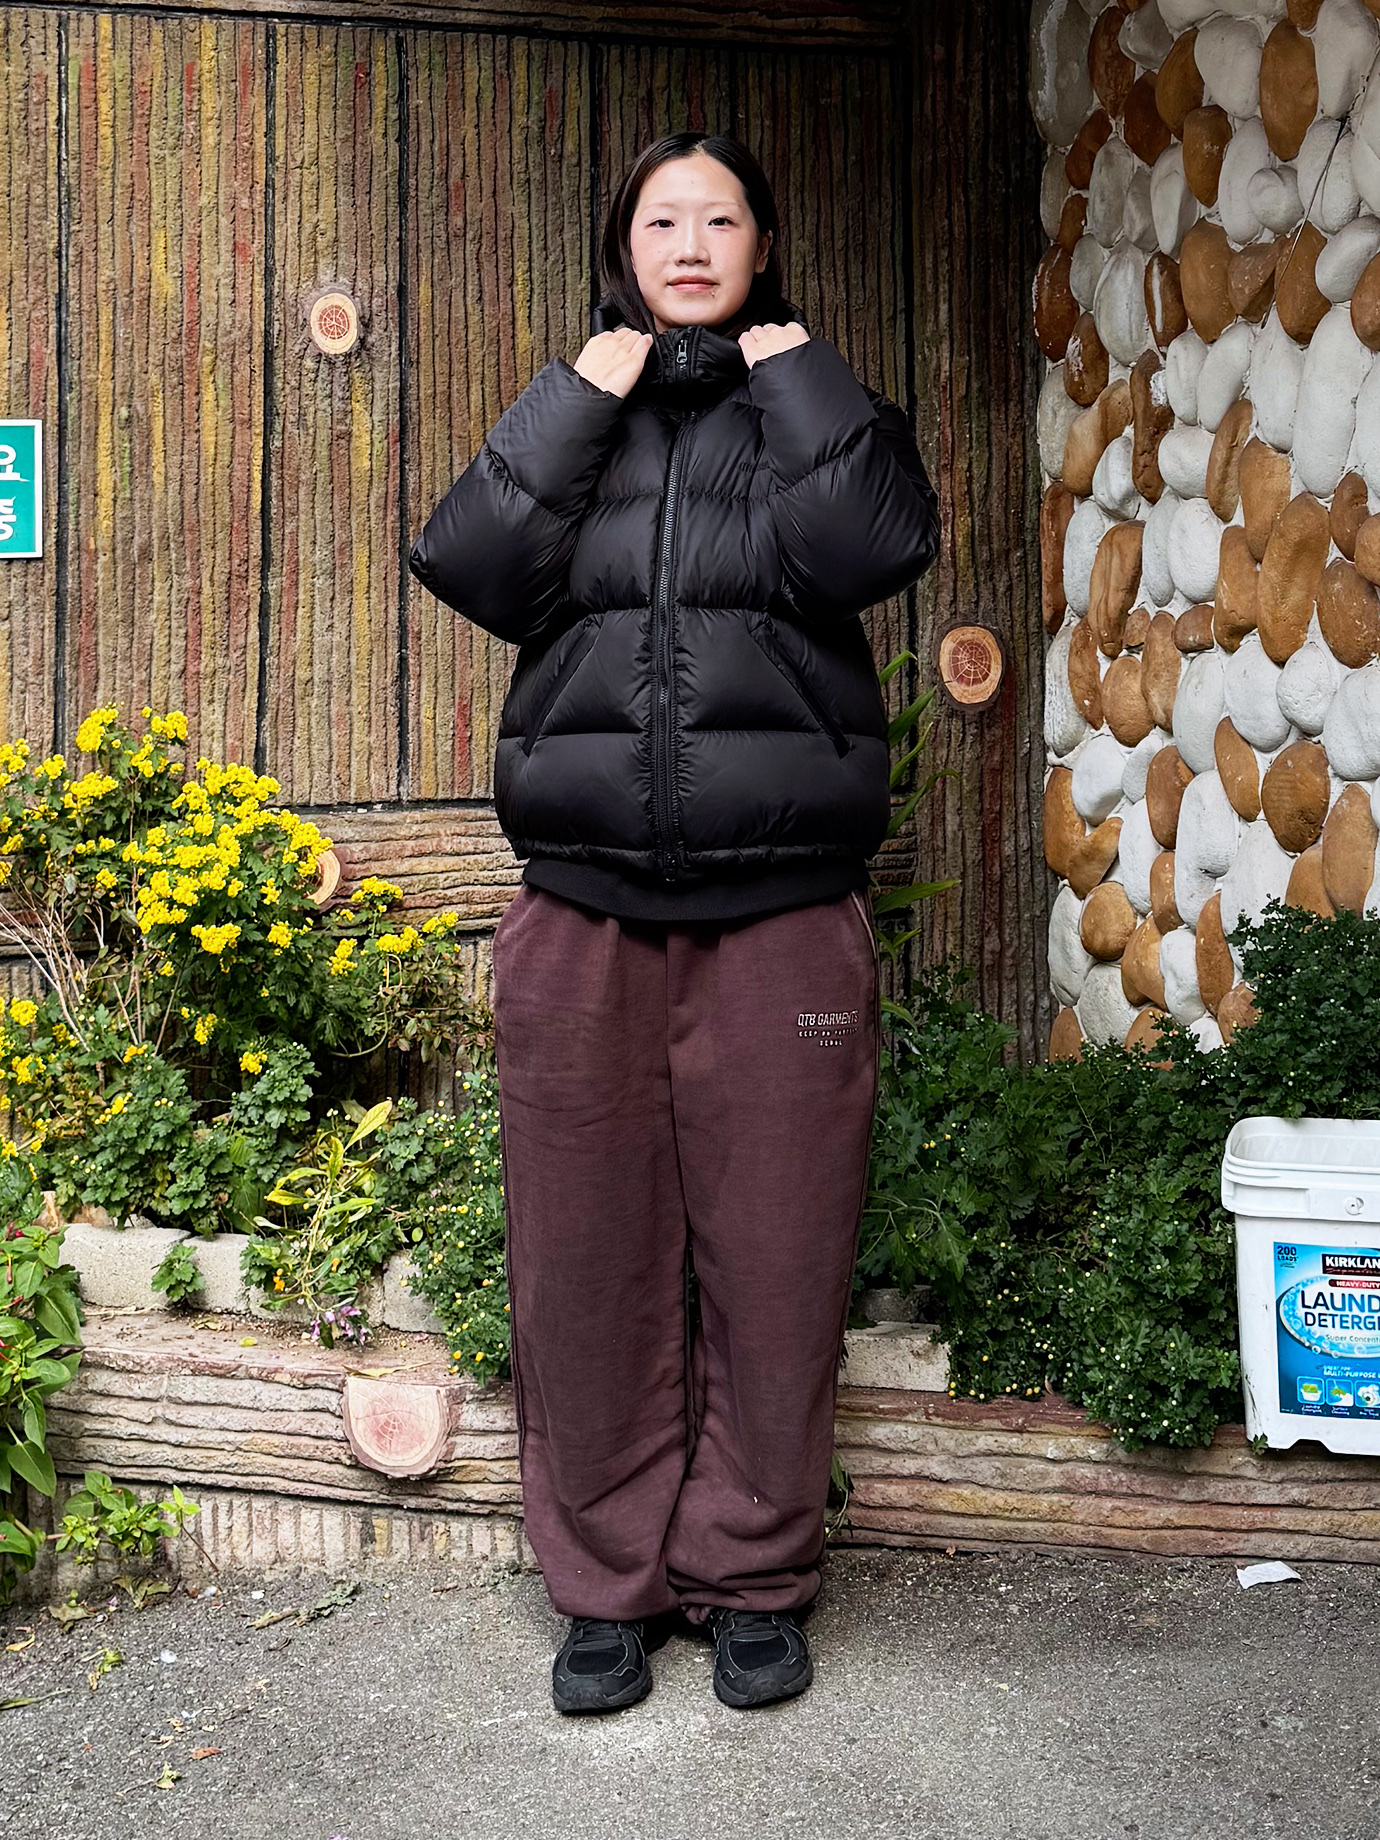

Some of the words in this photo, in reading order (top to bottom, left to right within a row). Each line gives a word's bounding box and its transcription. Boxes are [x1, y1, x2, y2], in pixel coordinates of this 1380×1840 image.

[1277, 1245, 1297, 1256] 200
[1301, 1290, 1380, 1313] LAUND
[1304, 1311, 1380, 1331] DETERG
[1325, 1334, 1347, 1342] Super
[1349, 1335, 1380, 1343] Concent
